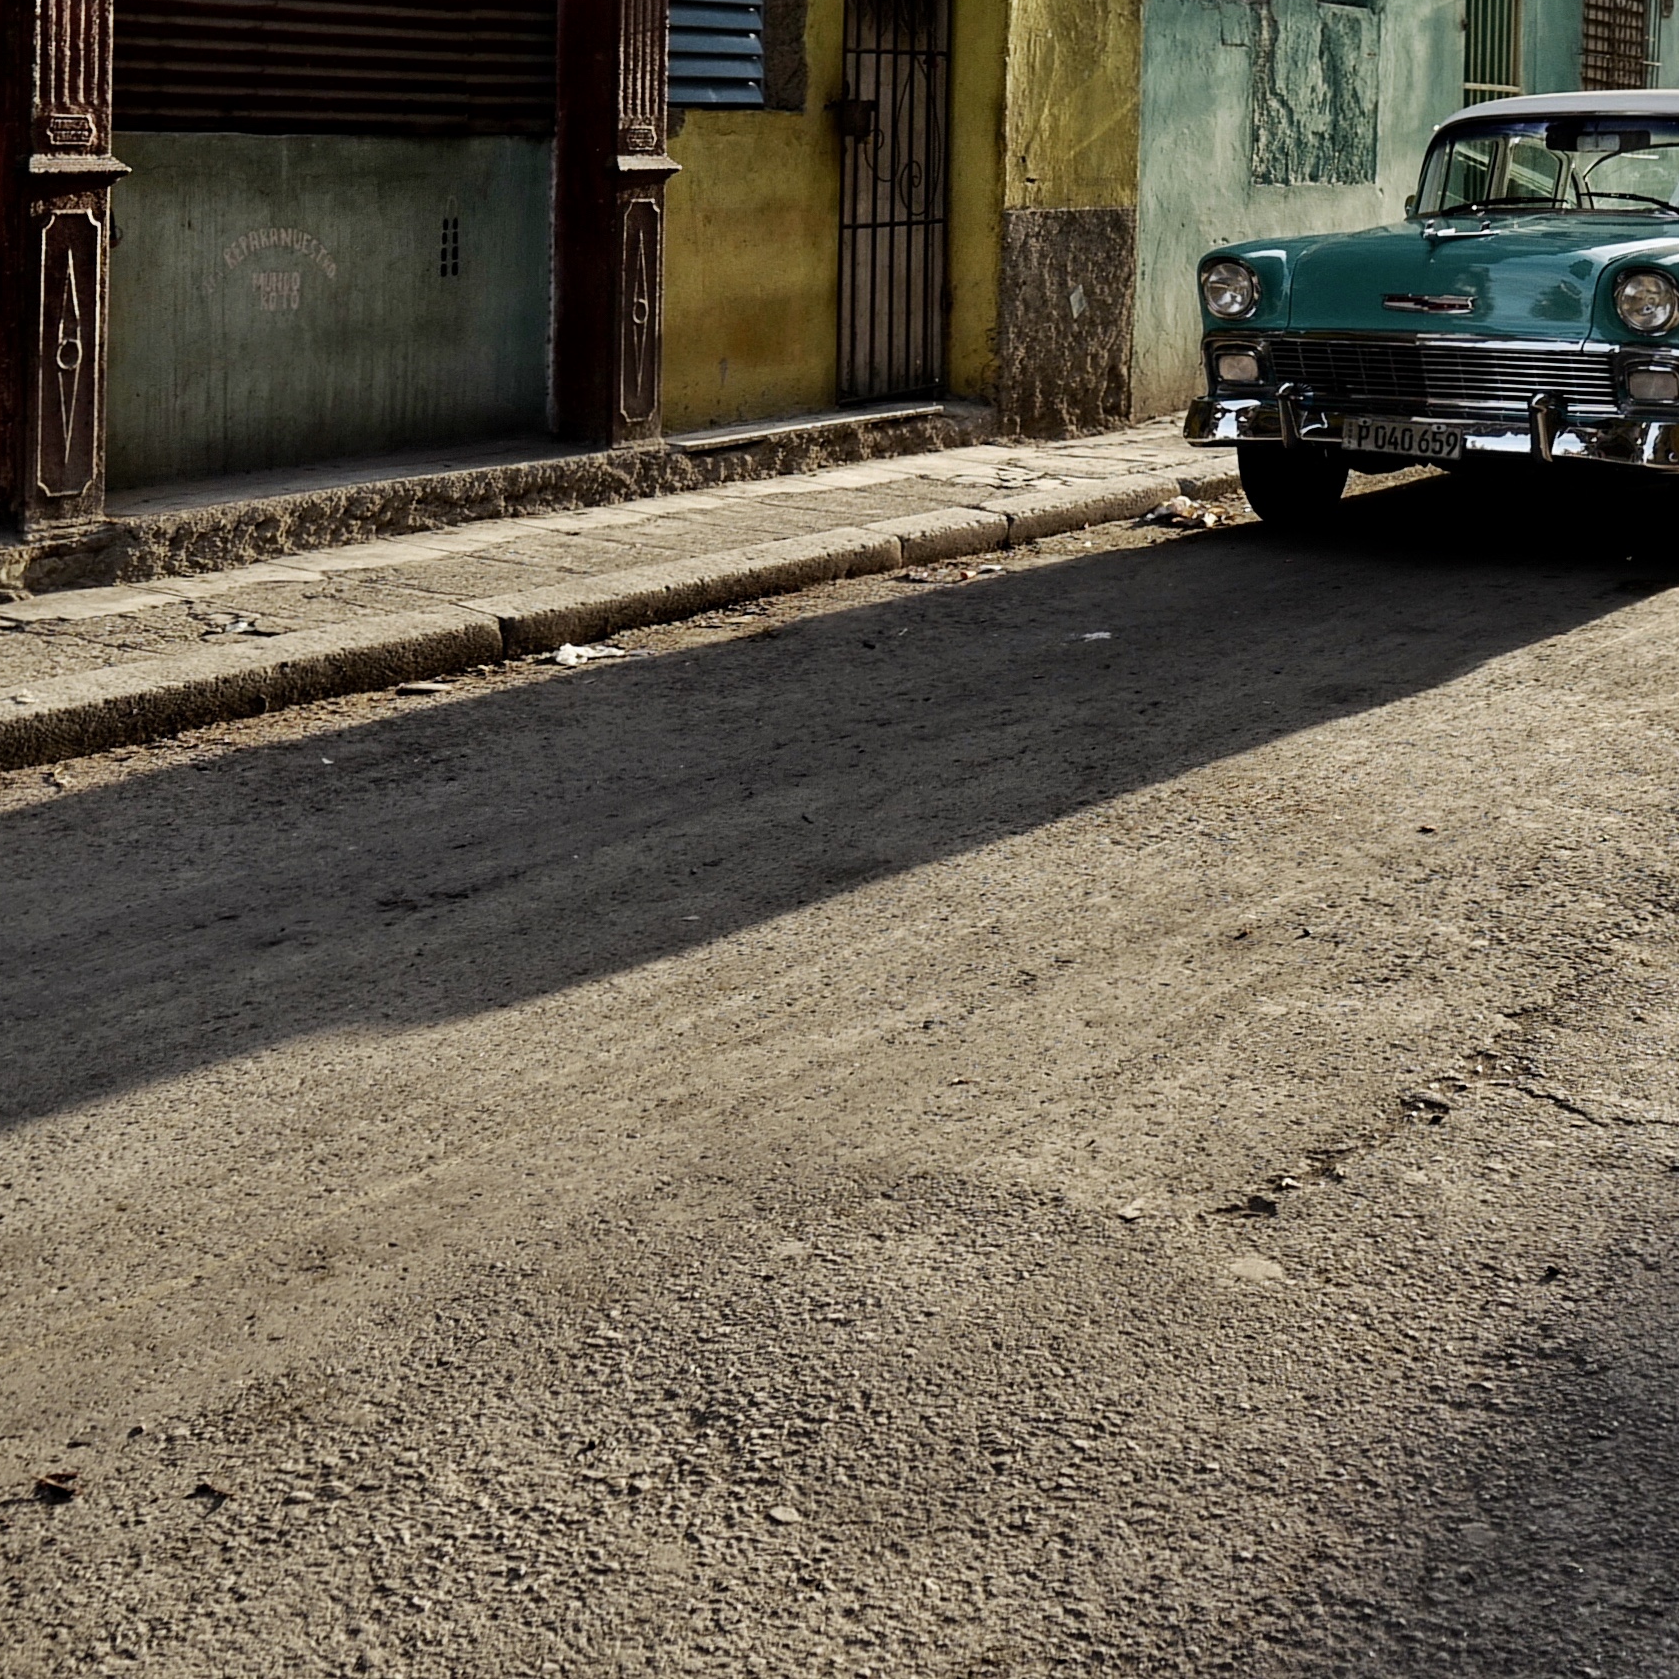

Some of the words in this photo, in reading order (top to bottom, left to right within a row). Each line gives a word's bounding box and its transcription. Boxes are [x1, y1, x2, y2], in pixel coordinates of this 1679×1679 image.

[259, 291, 300, 311] ROTO
[1357, 424, 1370, 448] P
[1374, 425, 1414, 452] 040
[1418, 429, 1459, 457] 659
